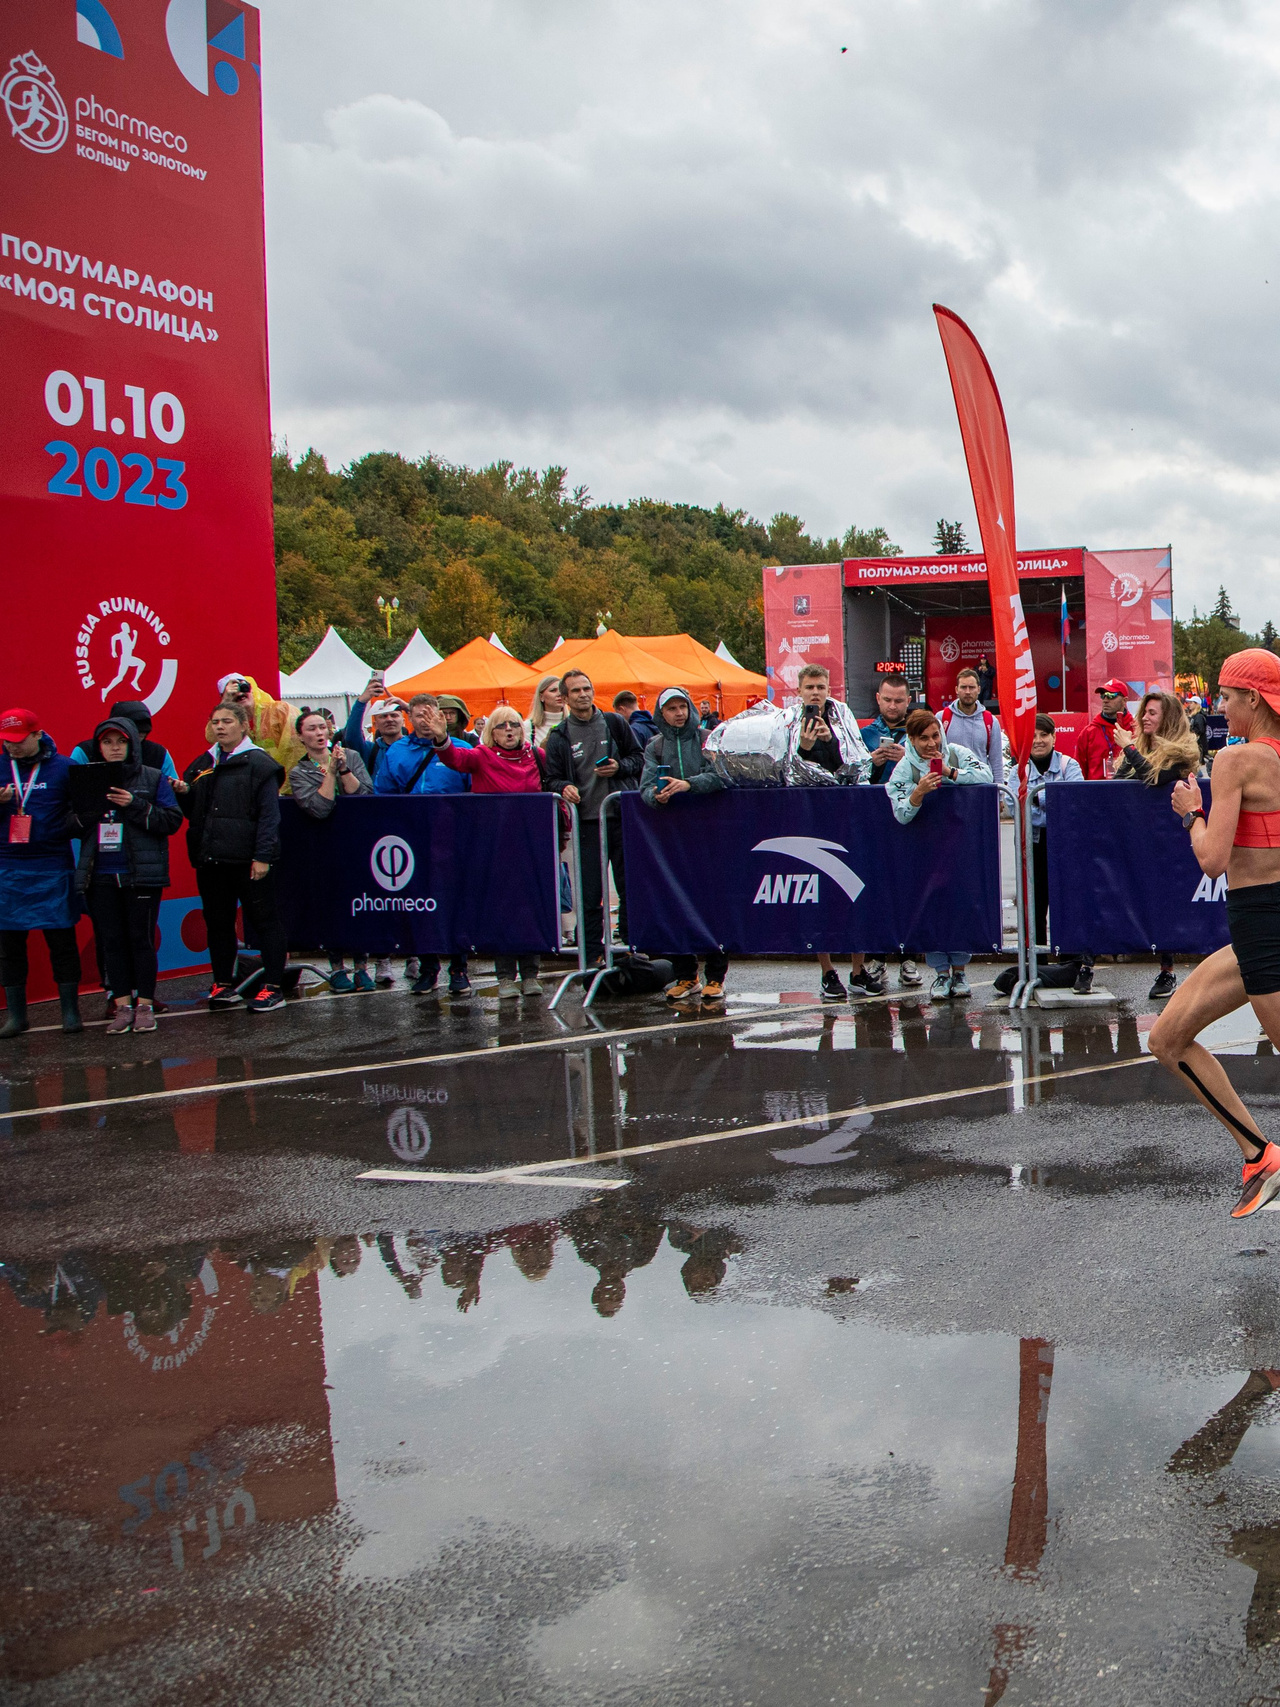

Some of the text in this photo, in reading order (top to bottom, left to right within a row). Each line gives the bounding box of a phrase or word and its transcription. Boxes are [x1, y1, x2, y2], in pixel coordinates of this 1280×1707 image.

[75, 95, 187, 154] pharmeco
[76, 125, 207, 181] БЕГОМ ПО ЗОЛОТОМУ
[76, 144, 130, 172] КОЛЬЦУ
[1, 233, 214, 312] ПОЛУМАРАФОН
[0, 273, 219, 343] «МОЯ СТОЛИЦА»
[44, 369, 186, 445] 01.10
[44, 440, 189, 510] 2023
[858, 559, 1068, 579] ПОЛУМАРАФОН «МО ОЛИЦА»
[75, 597, 171, 689] RUSSIA RUNNING
[792, 633, 830, 645] МОСКОВСКИЙ
[792, 644, 810, 653] СПОРТ
[961, 640, 995, 649] pharmec
[752, 874, 819, 904] ANTA
[1191, 872, 1229, 902] AN
[352, 892, 437, 917] pharmeco
